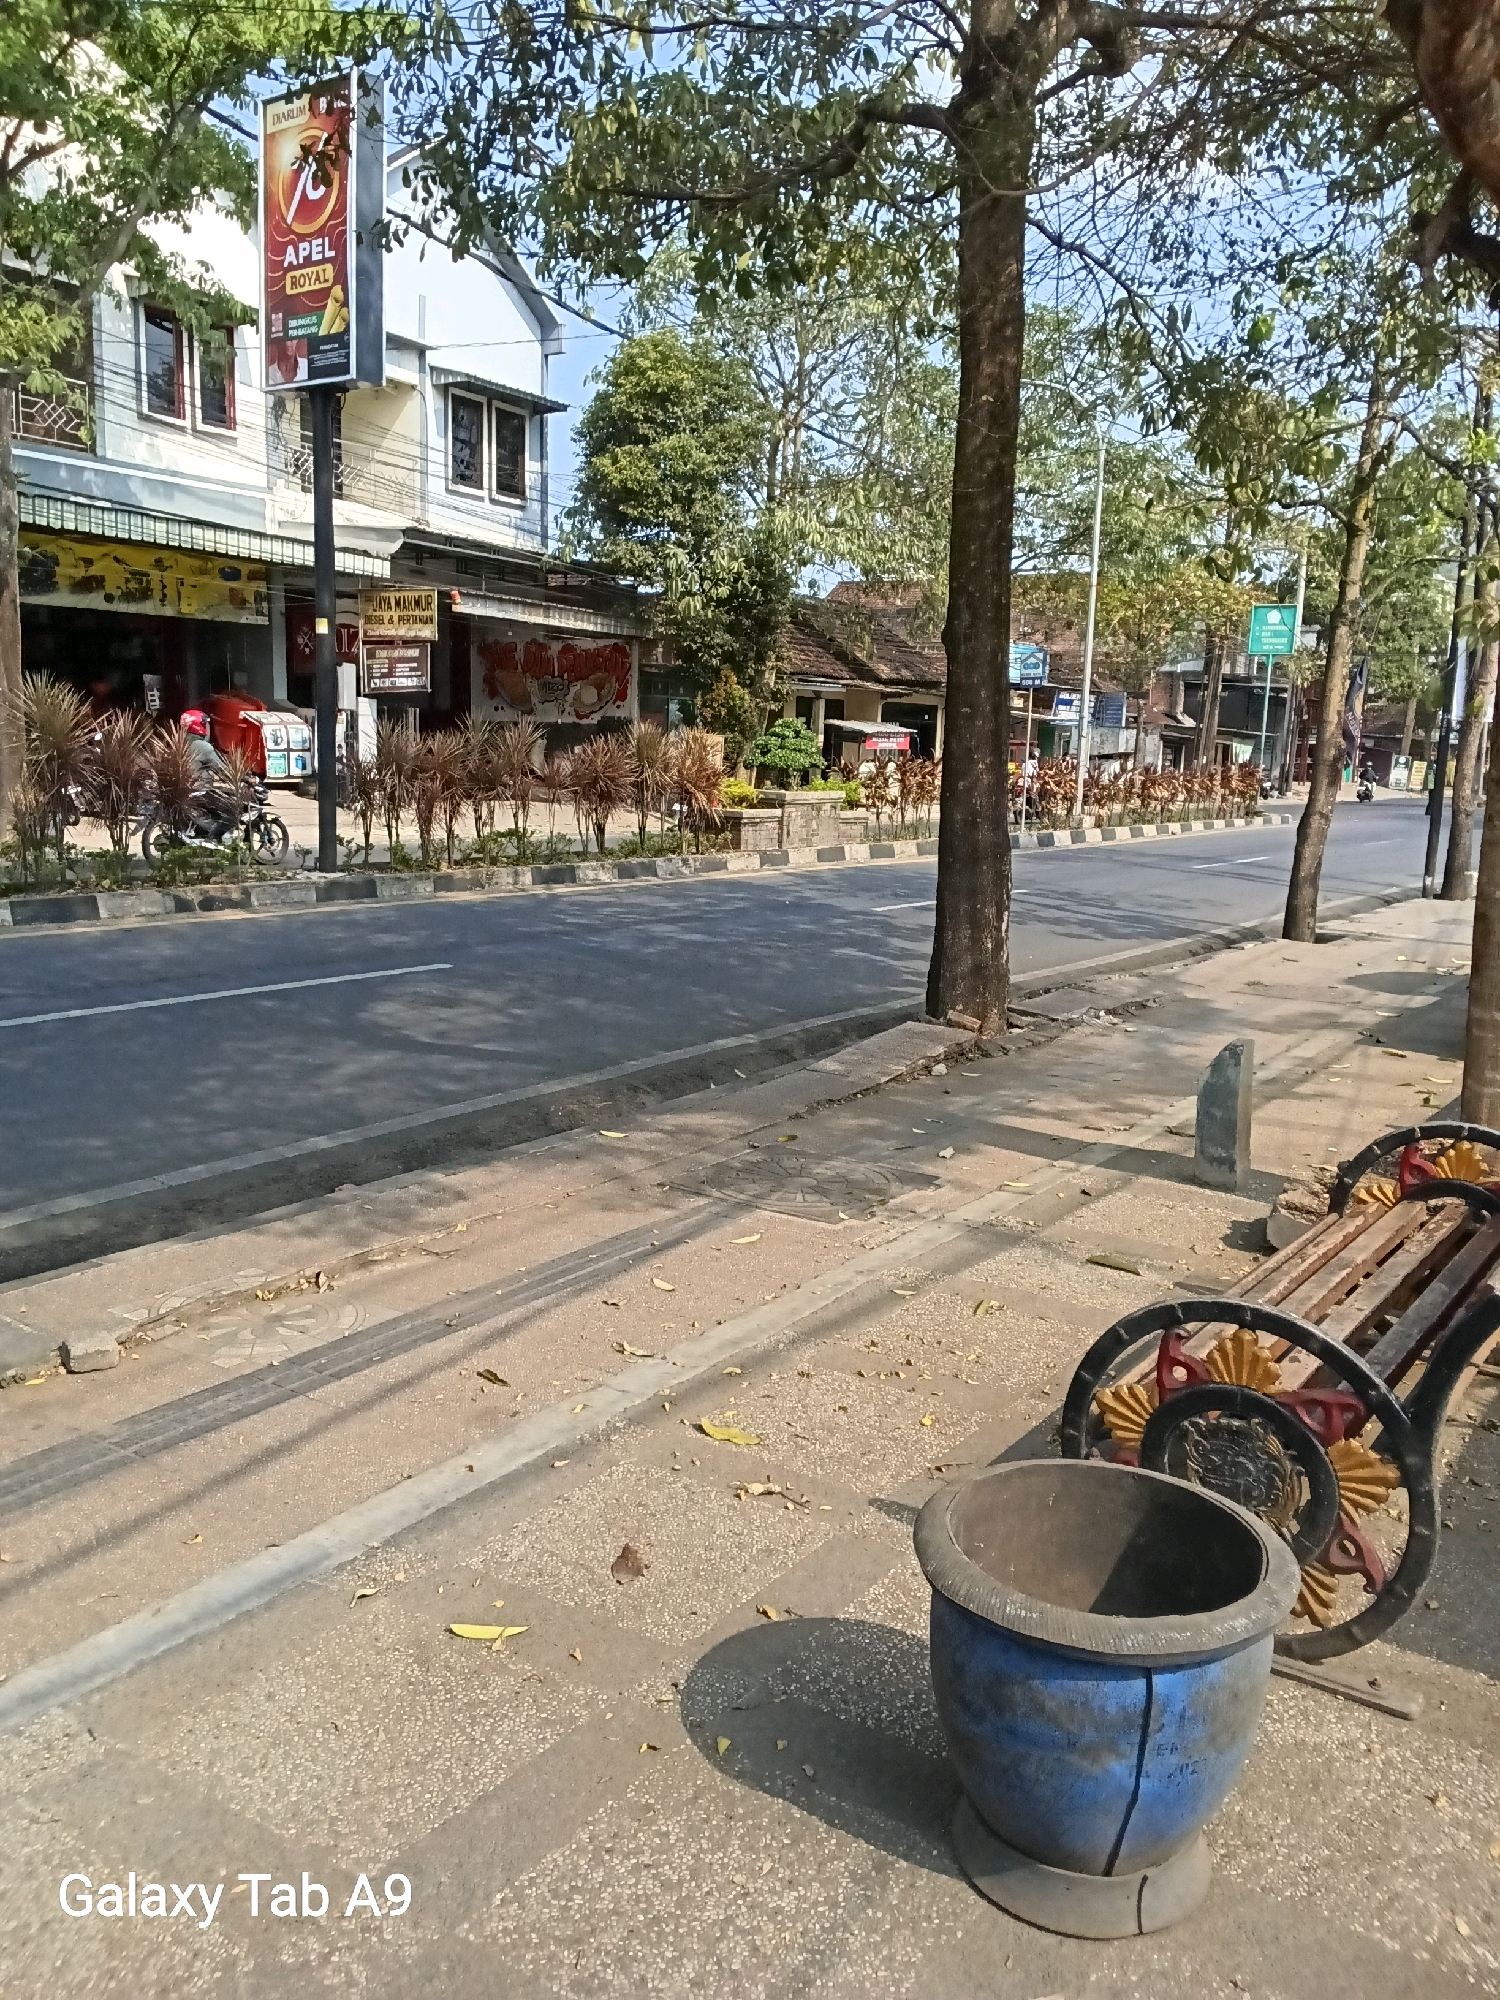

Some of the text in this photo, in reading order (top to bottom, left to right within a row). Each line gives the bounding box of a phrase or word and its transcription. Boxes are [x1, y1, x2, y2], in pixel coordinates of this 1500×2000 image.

[283, 237, 336, 268] APEL
[289, 268, 330, 290] ROYAL
[372, 595, 393, 612] JAYA
[394, 594, 434, 612] MAKMUR
[364, 614, 386, 625] DIESEL
[387, 614, 394, 625] &
